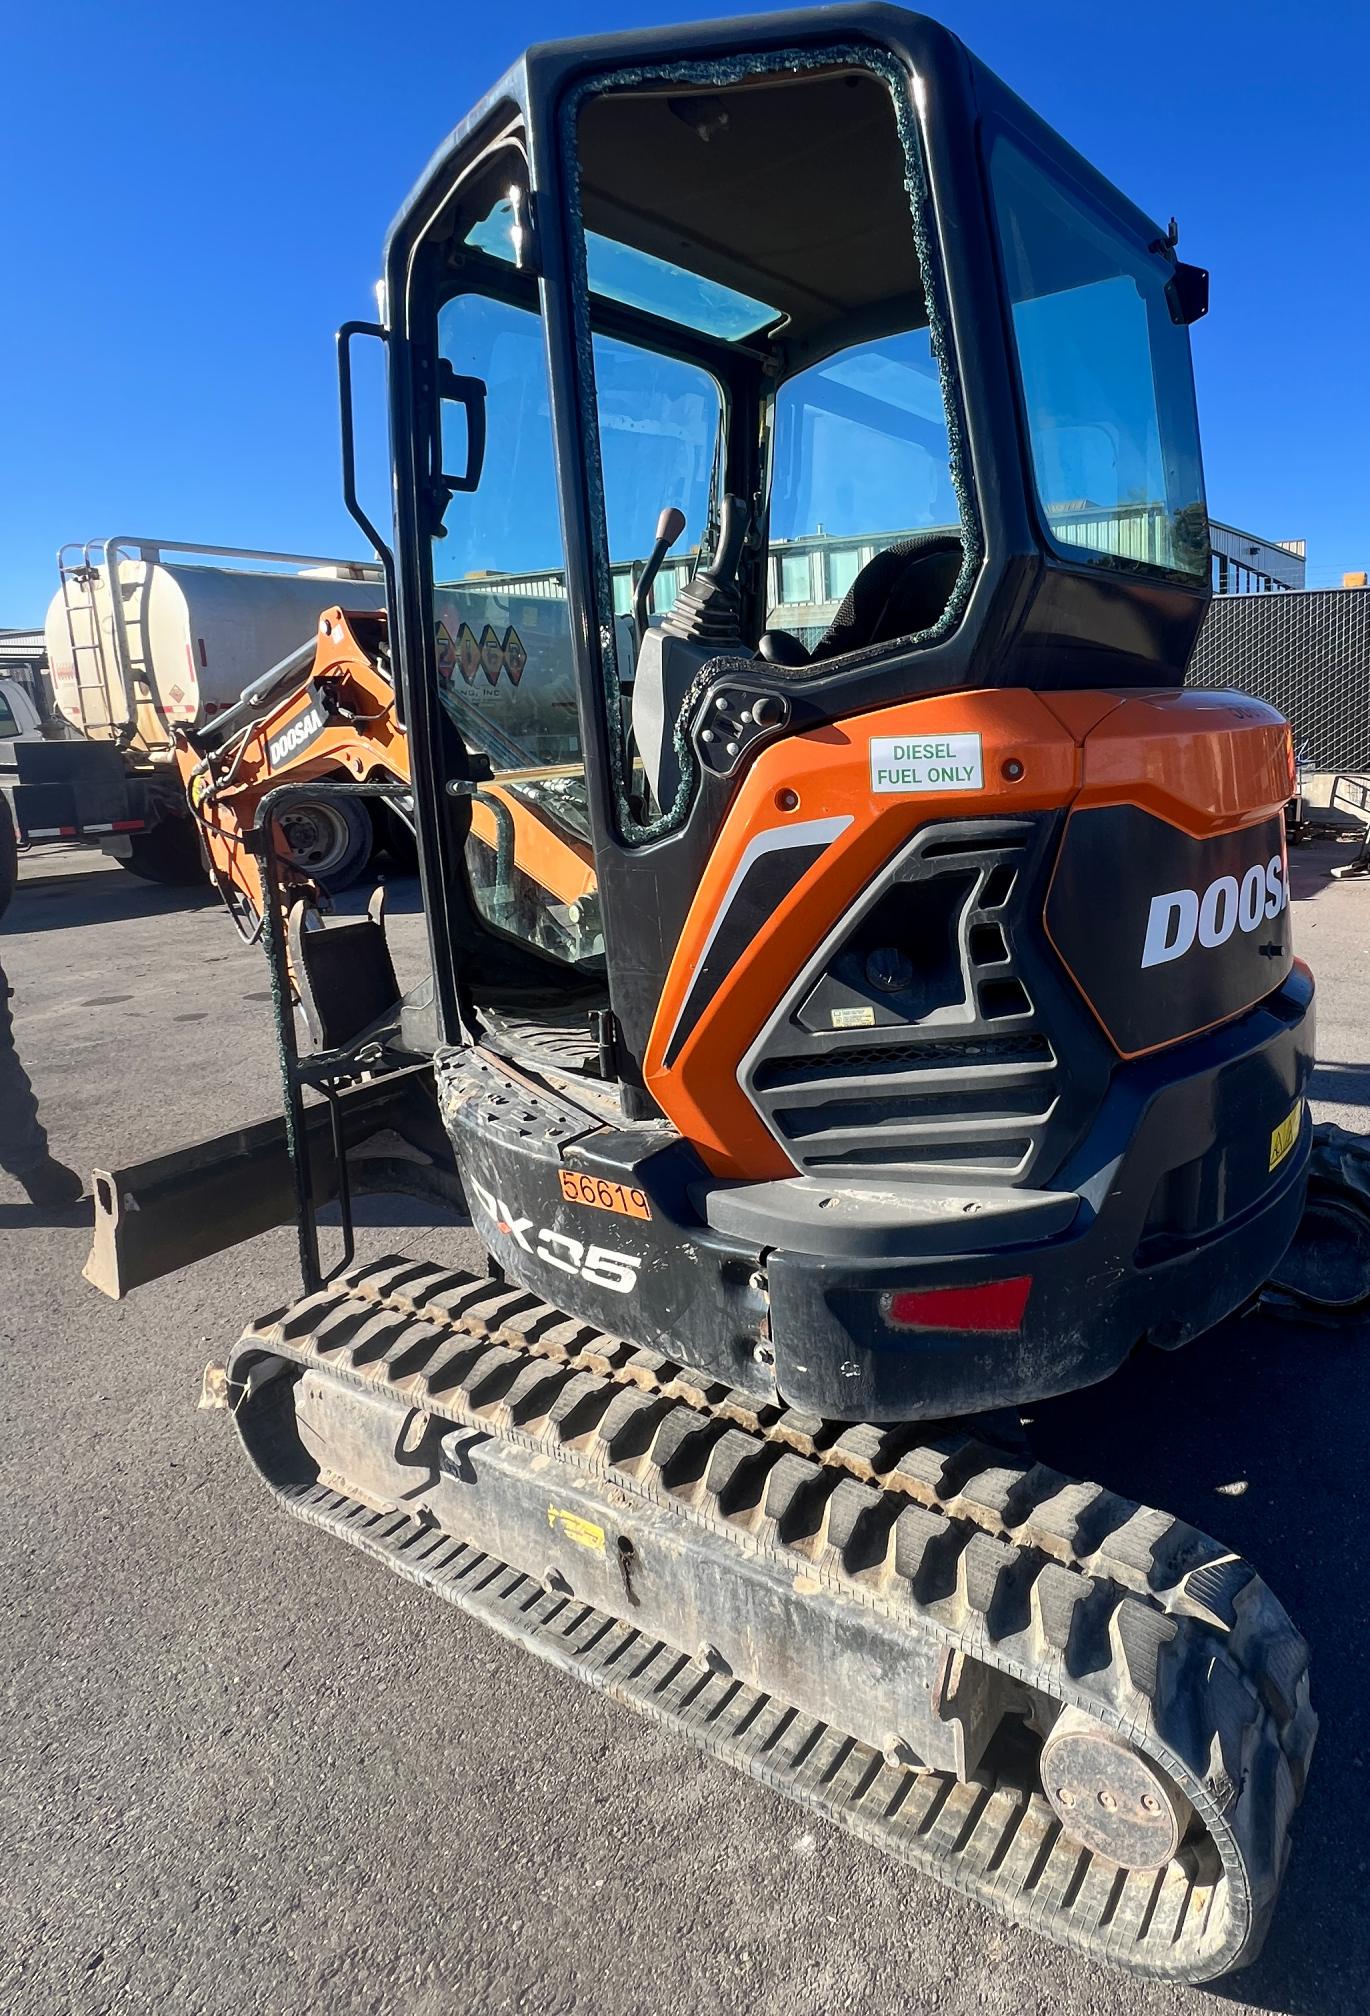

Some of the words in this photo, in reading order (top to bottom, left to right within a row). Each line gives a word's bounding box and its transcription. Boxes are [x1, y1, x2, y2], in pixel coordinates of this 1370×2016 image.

[893, 743, 957, 761] DIESEL
[877, 768, 923, 785] FUEL
[927, 765, 975, 783] ONLY
[562, 1171, 650, 1219] 56619
